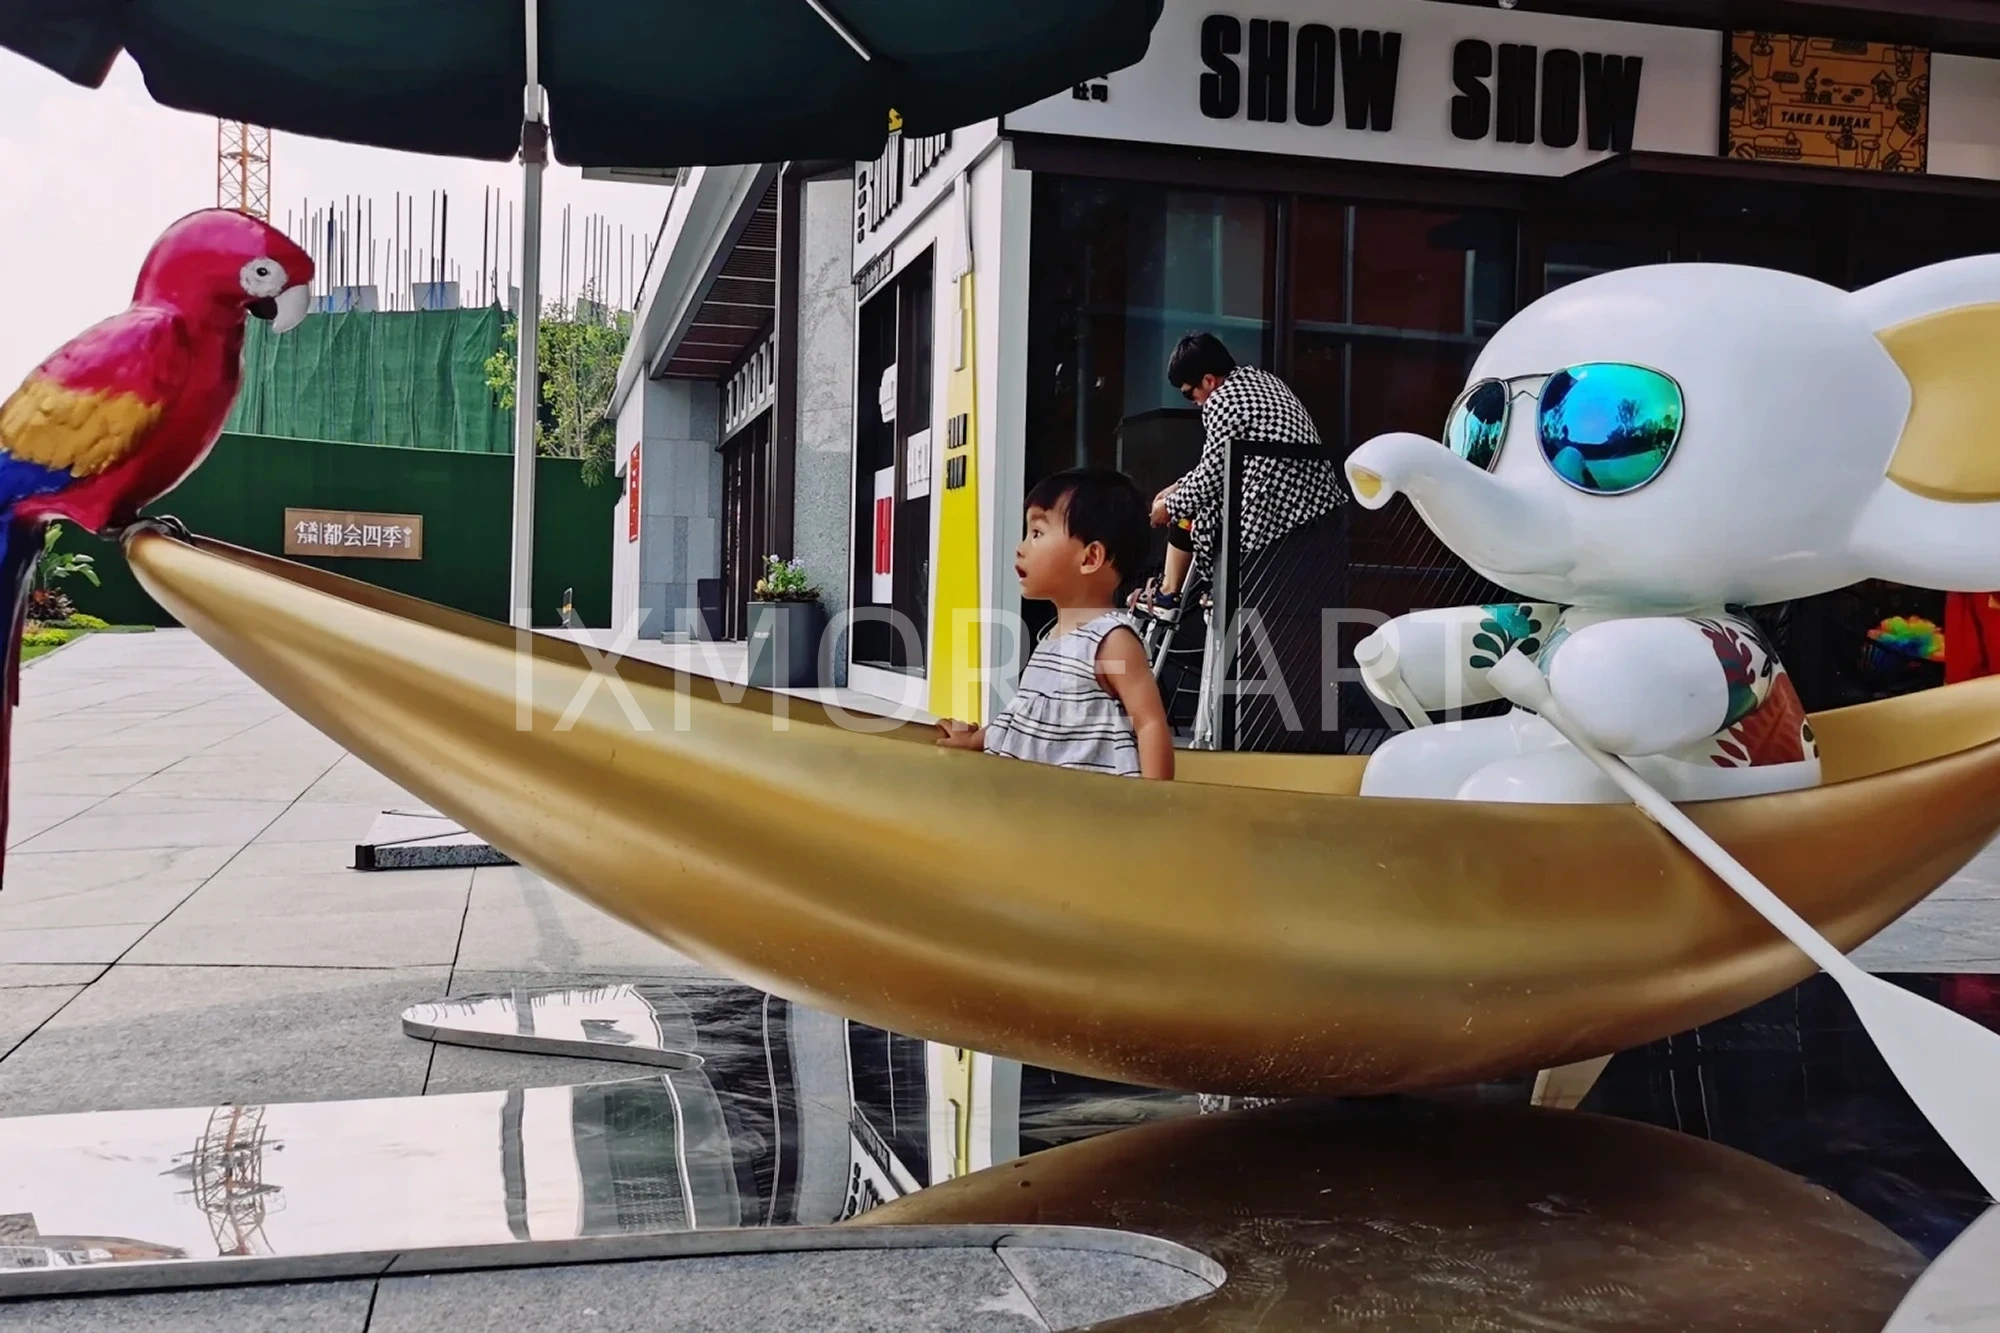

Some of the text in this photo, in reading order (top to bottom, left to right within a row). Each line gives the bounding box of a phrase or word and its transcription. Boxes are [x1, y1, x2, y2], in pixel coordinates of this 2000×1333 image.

[1200, 14, 1643, 153] SHOW SHOW
[1780, 111, 1871, 129] TAKE A BREAK
[323, 522, 402, 548] 都会四季
